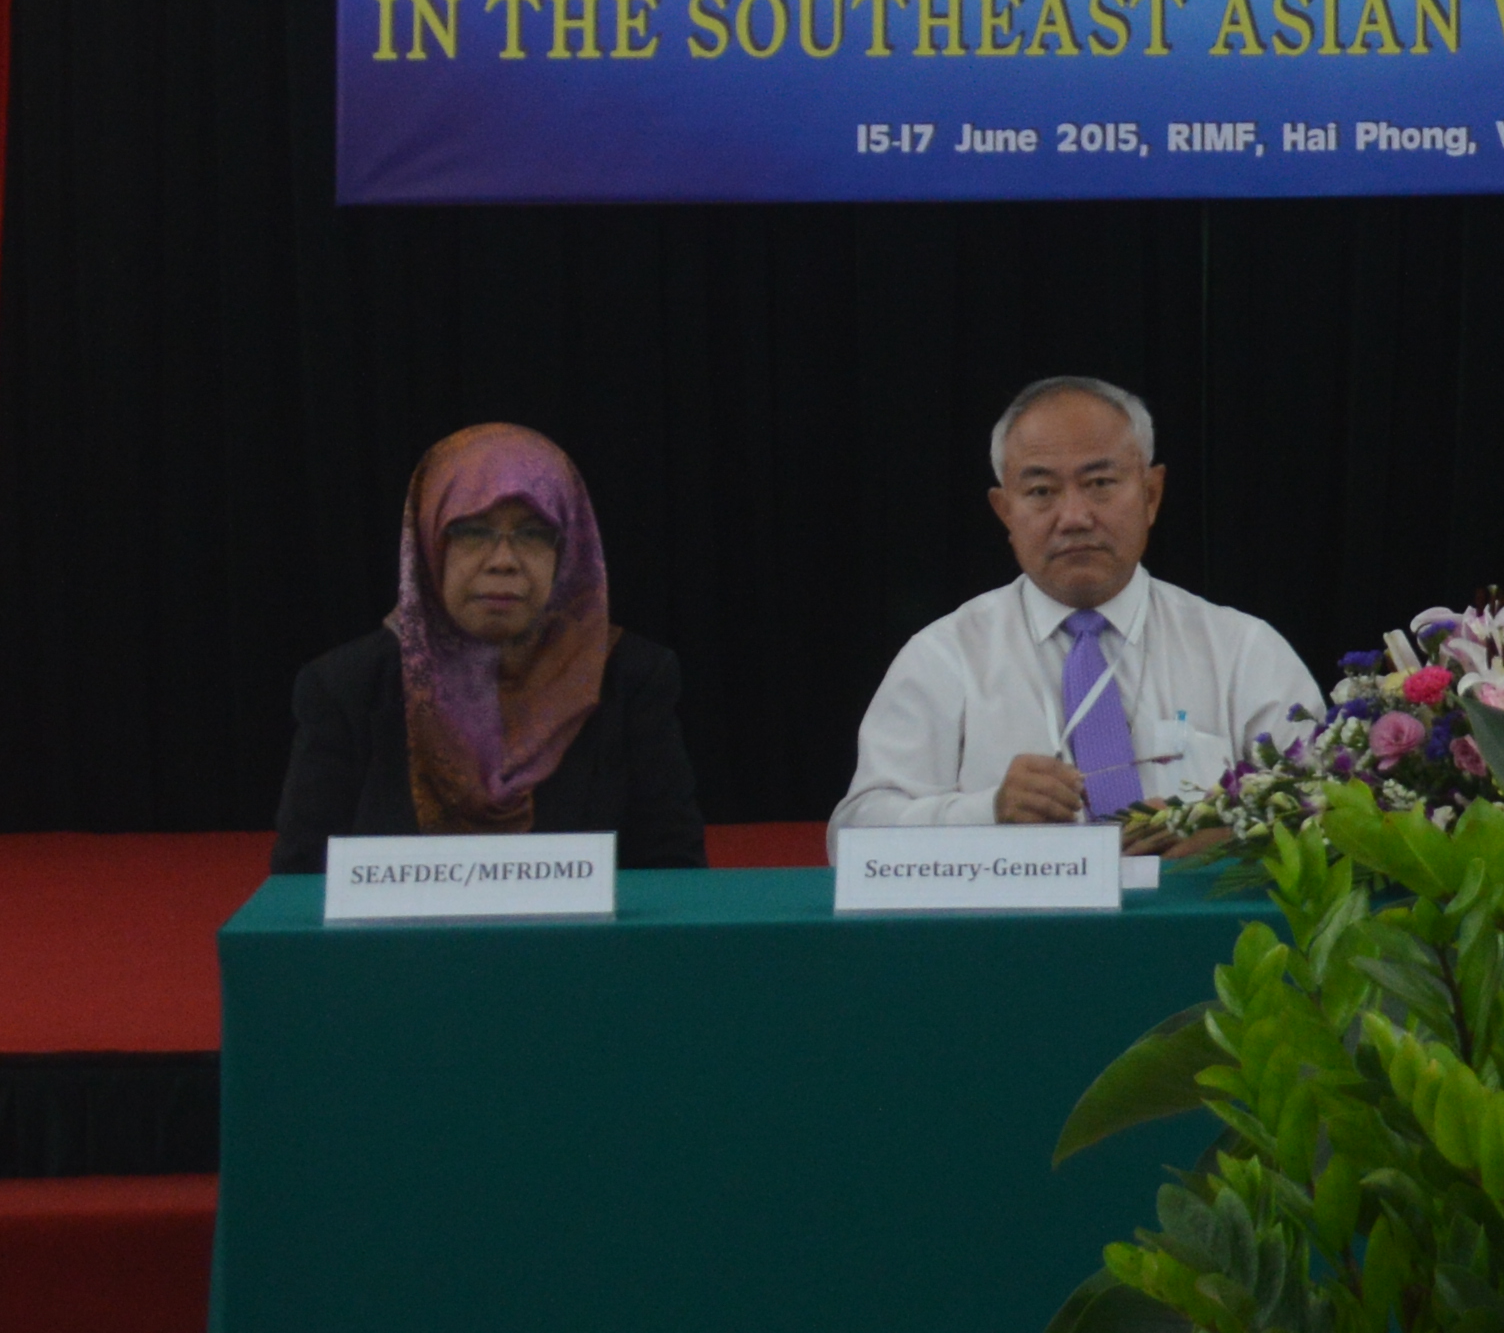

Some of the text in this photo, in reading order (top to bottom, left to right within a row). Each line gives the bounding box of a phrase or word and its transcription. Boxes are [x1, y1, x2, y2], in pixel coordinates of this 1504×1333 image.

[858, 124, 933, 152] 15-17
[956, 124, 1037, 152] June
[1058, 123, 1148, 156] 2015,
[1168, 123, 1263, 156] RIMF,
[1283, 123, 1336, 151] Hai
[1356, 122, 1476, 156] Phong,
[352, 861, 593, 884] SEAFDEC/MFRDMD
[866, 858, 1087, 881] Secretary-General
